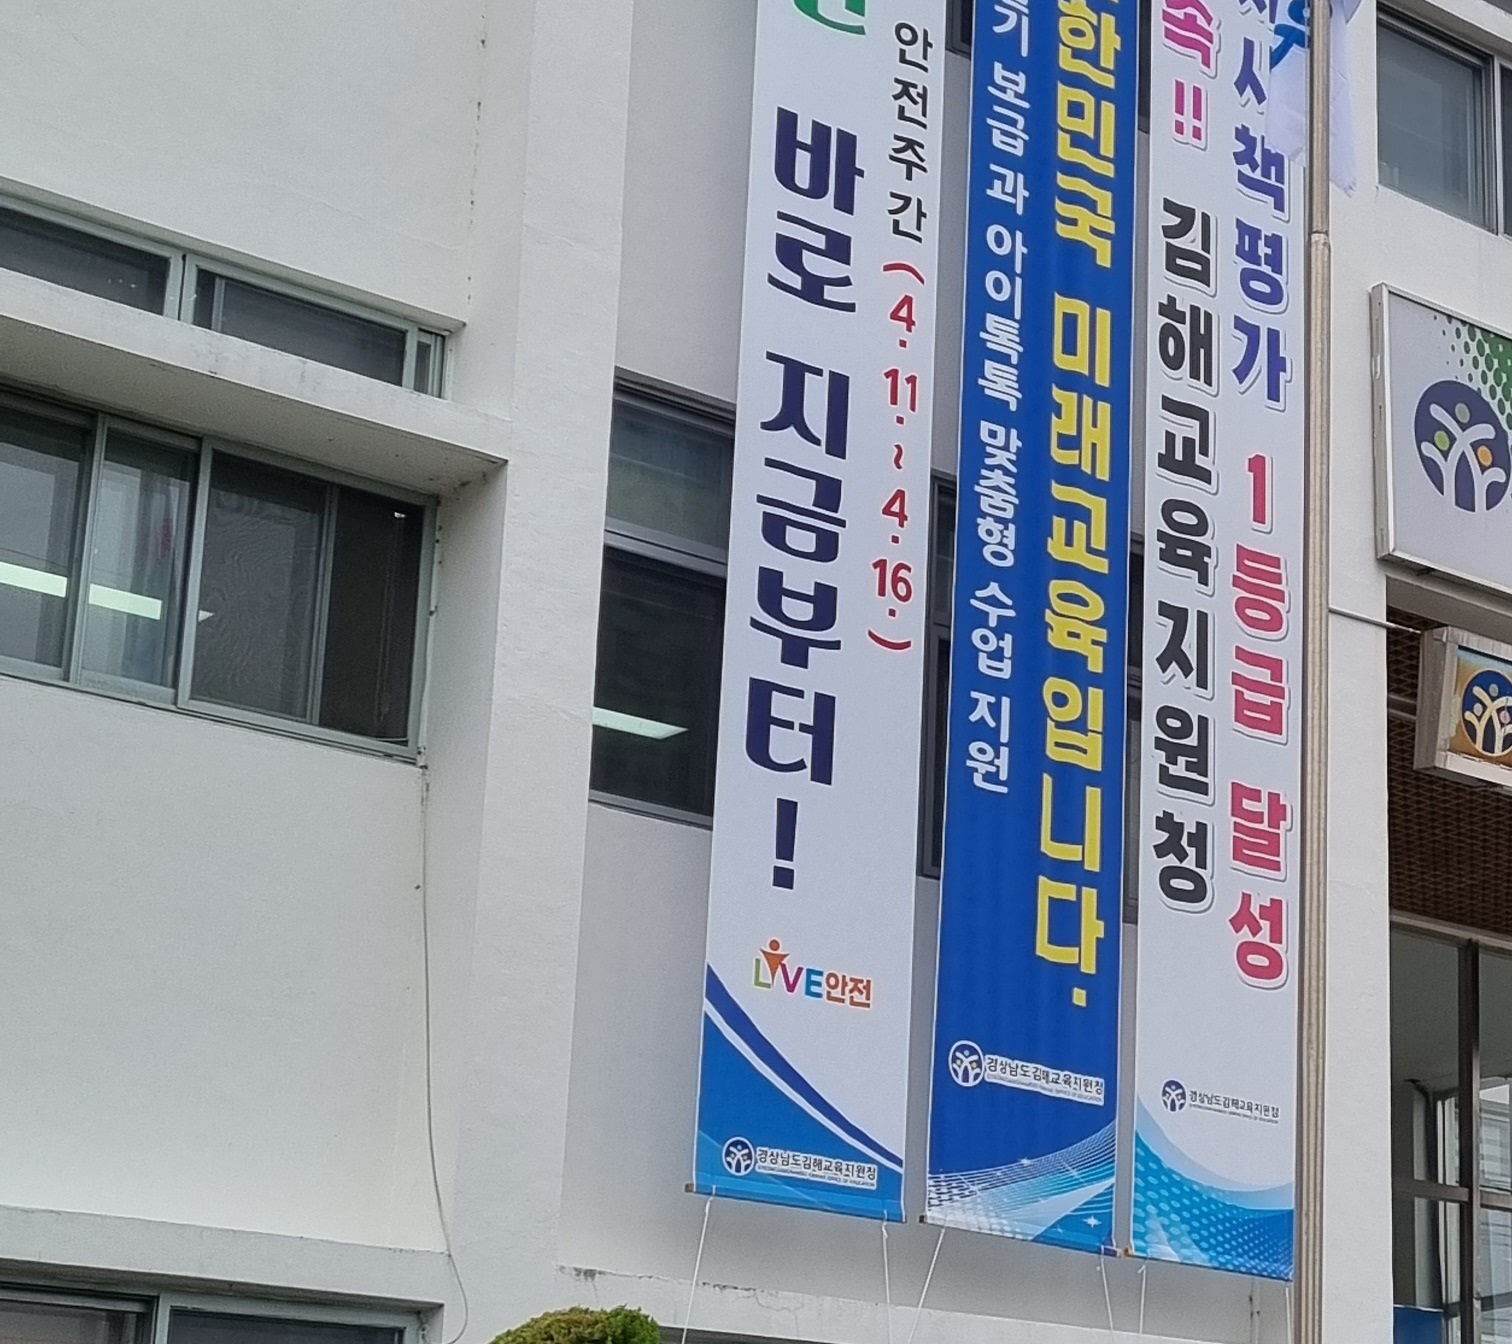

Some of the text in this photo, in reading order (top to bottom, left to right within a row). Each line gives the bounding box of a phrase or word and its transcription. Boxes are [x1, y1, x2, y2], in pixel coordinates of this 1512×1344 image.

[767, 105, 865, 314] 바로
[986, 63, 1032, 216] 보급과
[977, 223, 1029, 411] 아이톡톡
[976, 423, 1022, 567] 맞춤형
[1152, 197, 1217, 907] 김해교육지원청
[1229, 453, 1287, 737] 1등급
[745, 350, 850, 891] 지금부터!
[969, 581, 1016, 681] 수업
[1034, 291, 1112, 1007] 미래교육입니다.
[965, 690, 1011, 793] 지원
[1229, 780, 1291, 984] 달성
